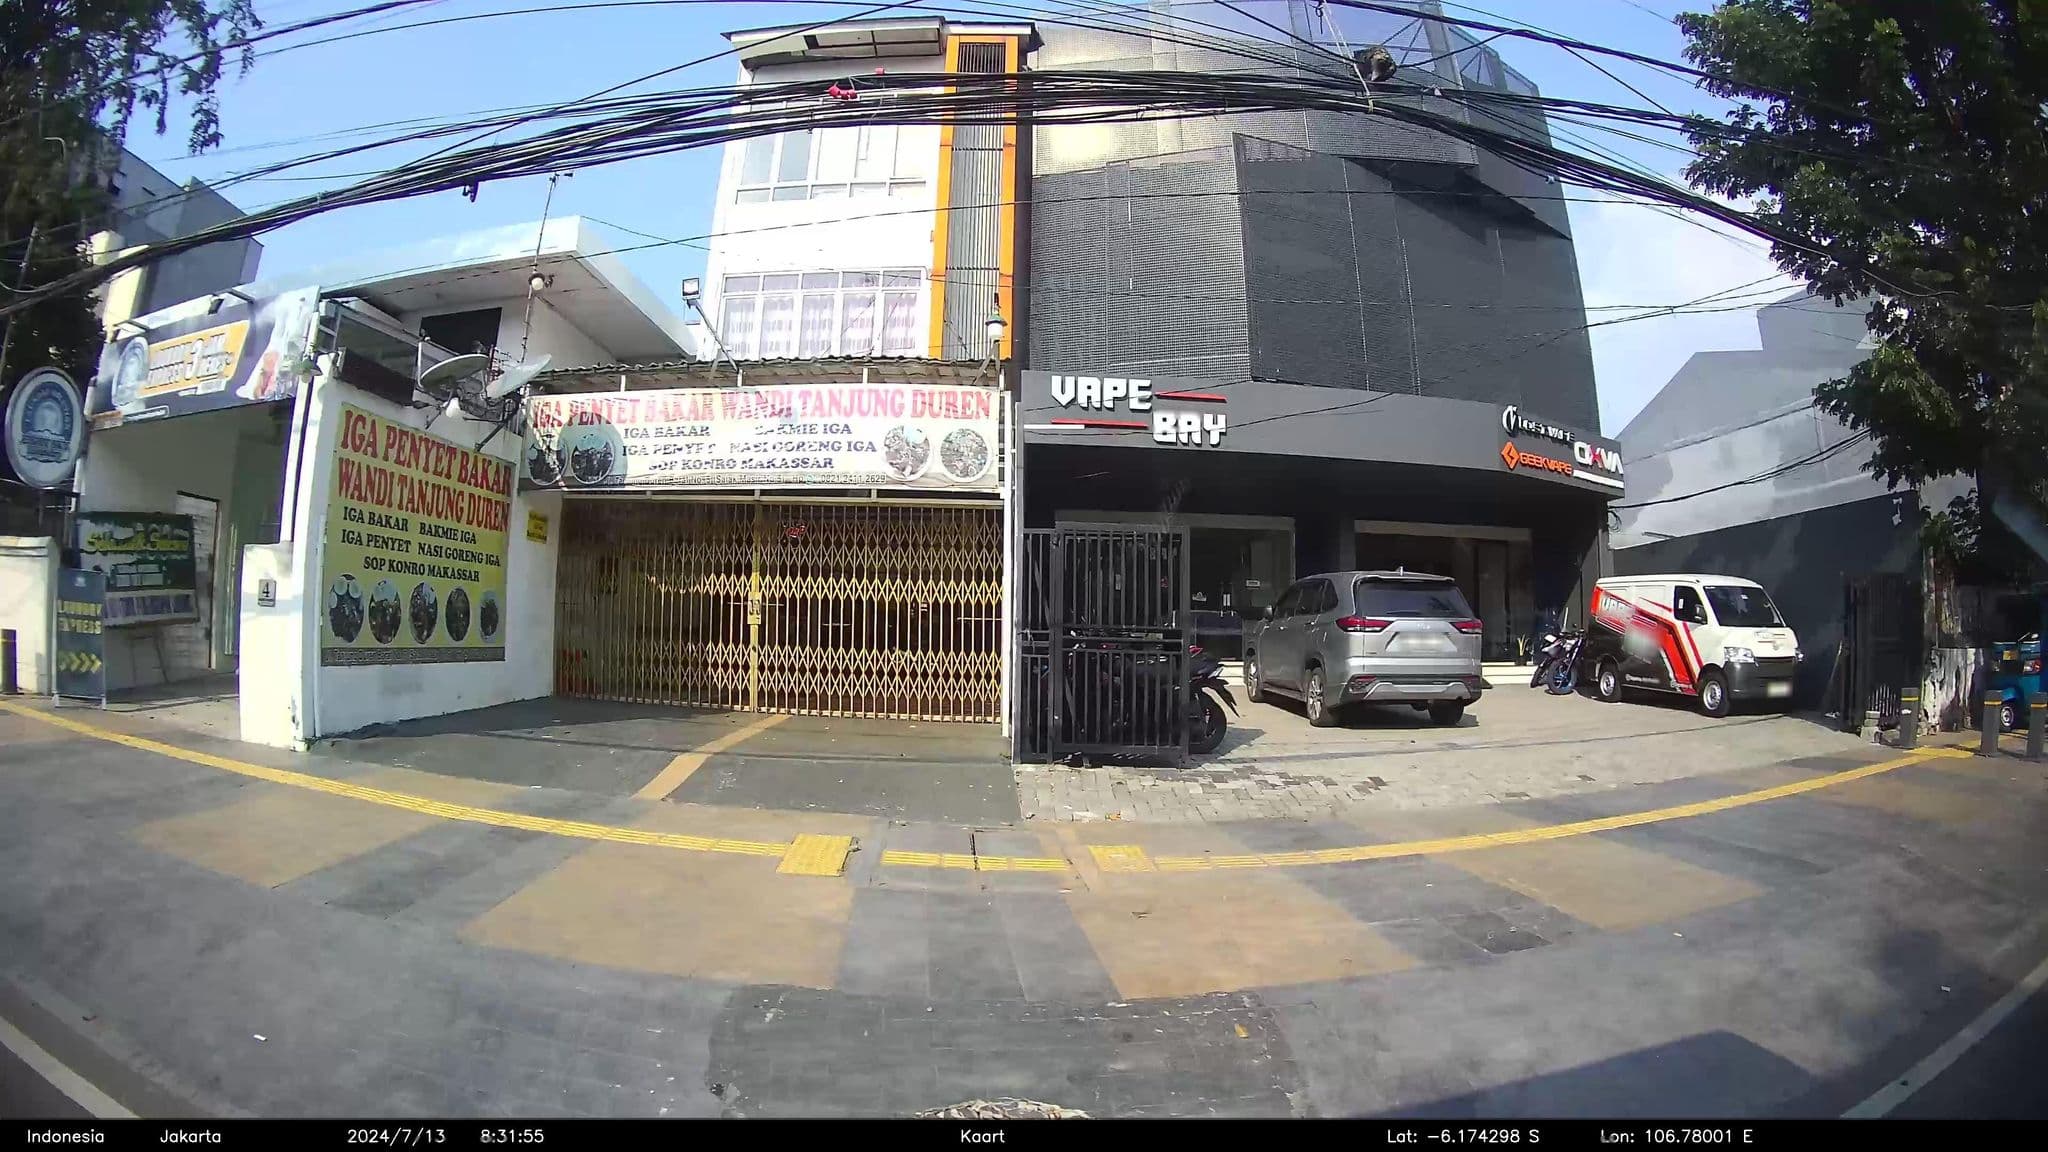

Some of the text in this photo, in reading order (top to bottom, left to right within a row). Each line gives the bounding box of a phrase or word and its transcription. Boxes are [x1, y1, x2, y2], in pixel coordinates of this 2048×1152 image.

[532, 400, 563, 428] IGA
[567, 398, 641, 427] PENYET
[721, 390, 793, 420] WANDI
[798, 388, 905, 418] TANJUNG
[910, 389, 993, 420] DUREN
[1051, 375, 1153, 411] VAPE
[623, 427, 651, 439] IGA
[822, 423, 853, 435] IGA
[1152, 411, 1227, 446] BAY
[340, 409, 513, 498] IGA PENYET BAKAR
[622, 444, 650, 457] IGA
[846, 440, 877, 452] IGA
[681, 458, 738, 470] KONRO
[740, 457, 835, 469] MAKASSAR
[1520, 452, 1573, 475] GEEKVAPE
[338, 456, 396, 509] WANDI
[396, 473, 465, 524] TANJUNG
[465, 491, 512, 533] DUREN
[342, 506, 477, 545] IGA BAKAR BAKMIE IGA
[341, 529, 501, 567] IGA PENYET NASI GORENG IGA
[363, 555, 481, 583] SOP KONRO MAKASSAR
[261, 581, 271, 598] 4
